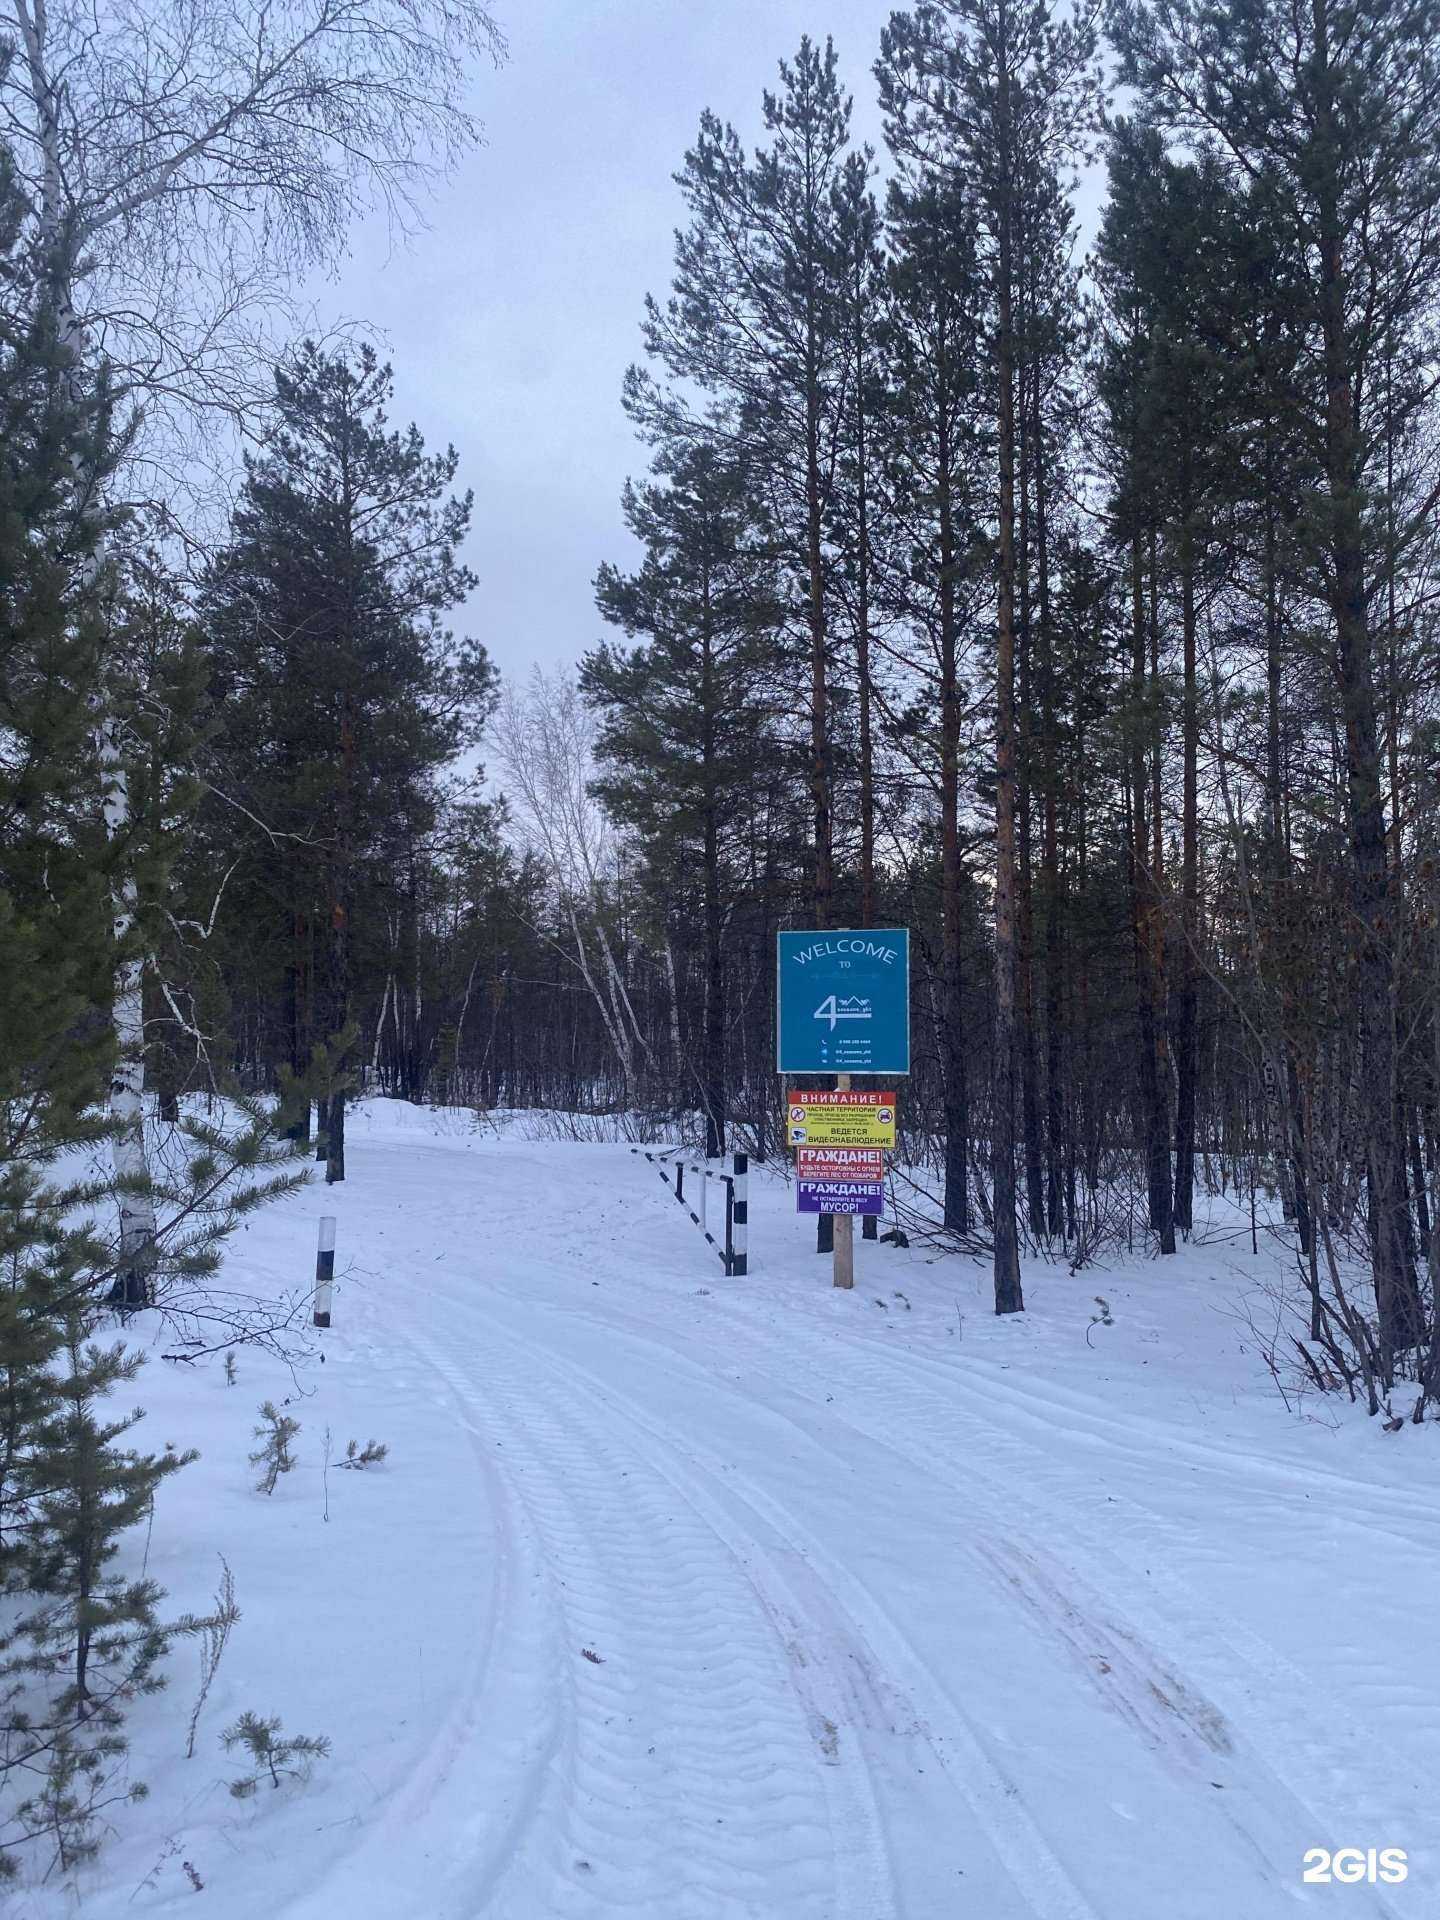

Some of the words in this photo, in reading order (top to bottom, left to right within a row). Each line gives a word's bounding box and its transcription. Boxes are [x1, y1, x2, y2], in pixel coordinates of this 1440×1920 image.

[792, 939, 899, 965] WELCOME
[838, 960, 851, 969] TO
[801, 1094, 882, 1104] ВНИМАНИЕ!
[830, 1128, 868, 1136] ВЕДЕТСЯ
[808, 1136, 891, 1145] ВИДЕОНАБЛЮДЕНИЕ
[799, 1150, 880, 1164] ГРАЖДАНЕ!
[799, 1182, 881, 1196] ГРАЖДАНЕ!
[820, 1202, 859, 1213] МУСОР!
